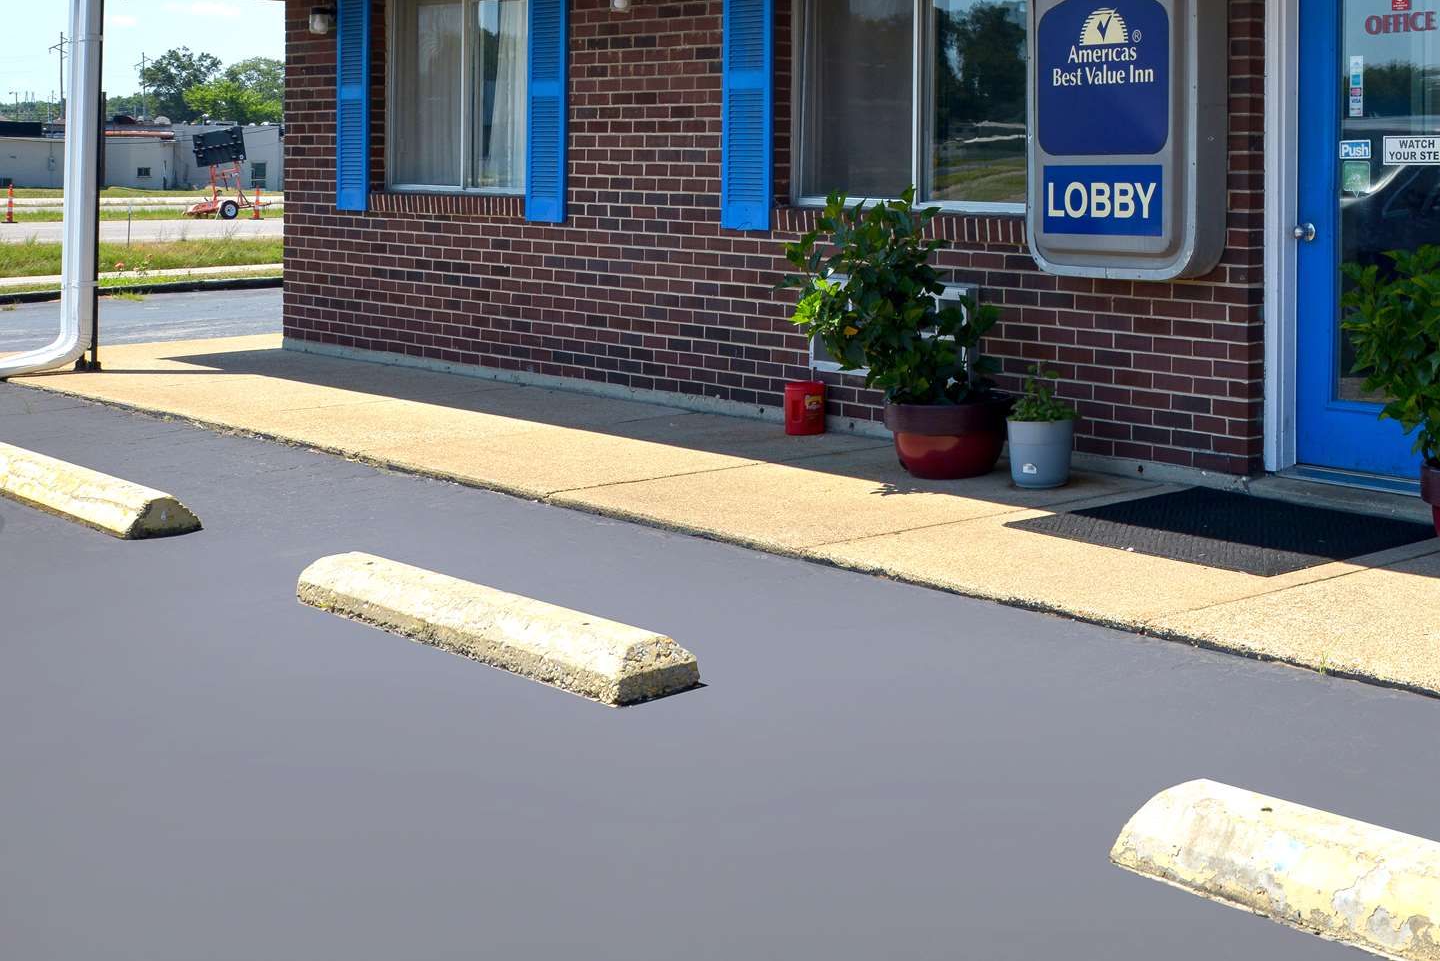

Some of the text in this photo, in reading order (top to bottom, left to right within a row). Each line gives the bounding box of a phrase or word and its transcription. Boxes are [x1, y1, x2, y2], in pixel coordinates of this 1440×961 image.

[1365, 11, 1438, 35] OFFICE
[1068, 45, 1137, 64] Americas
[1053, 64, 1154, 86] Best Value Inn
[1341, 143, 1369, 157] Push
[1399, 139, 1435, 149] WATCH
[1389, 151, 1417, 161] YOUR
[1048, 182, 1156, 219] LOBBY
